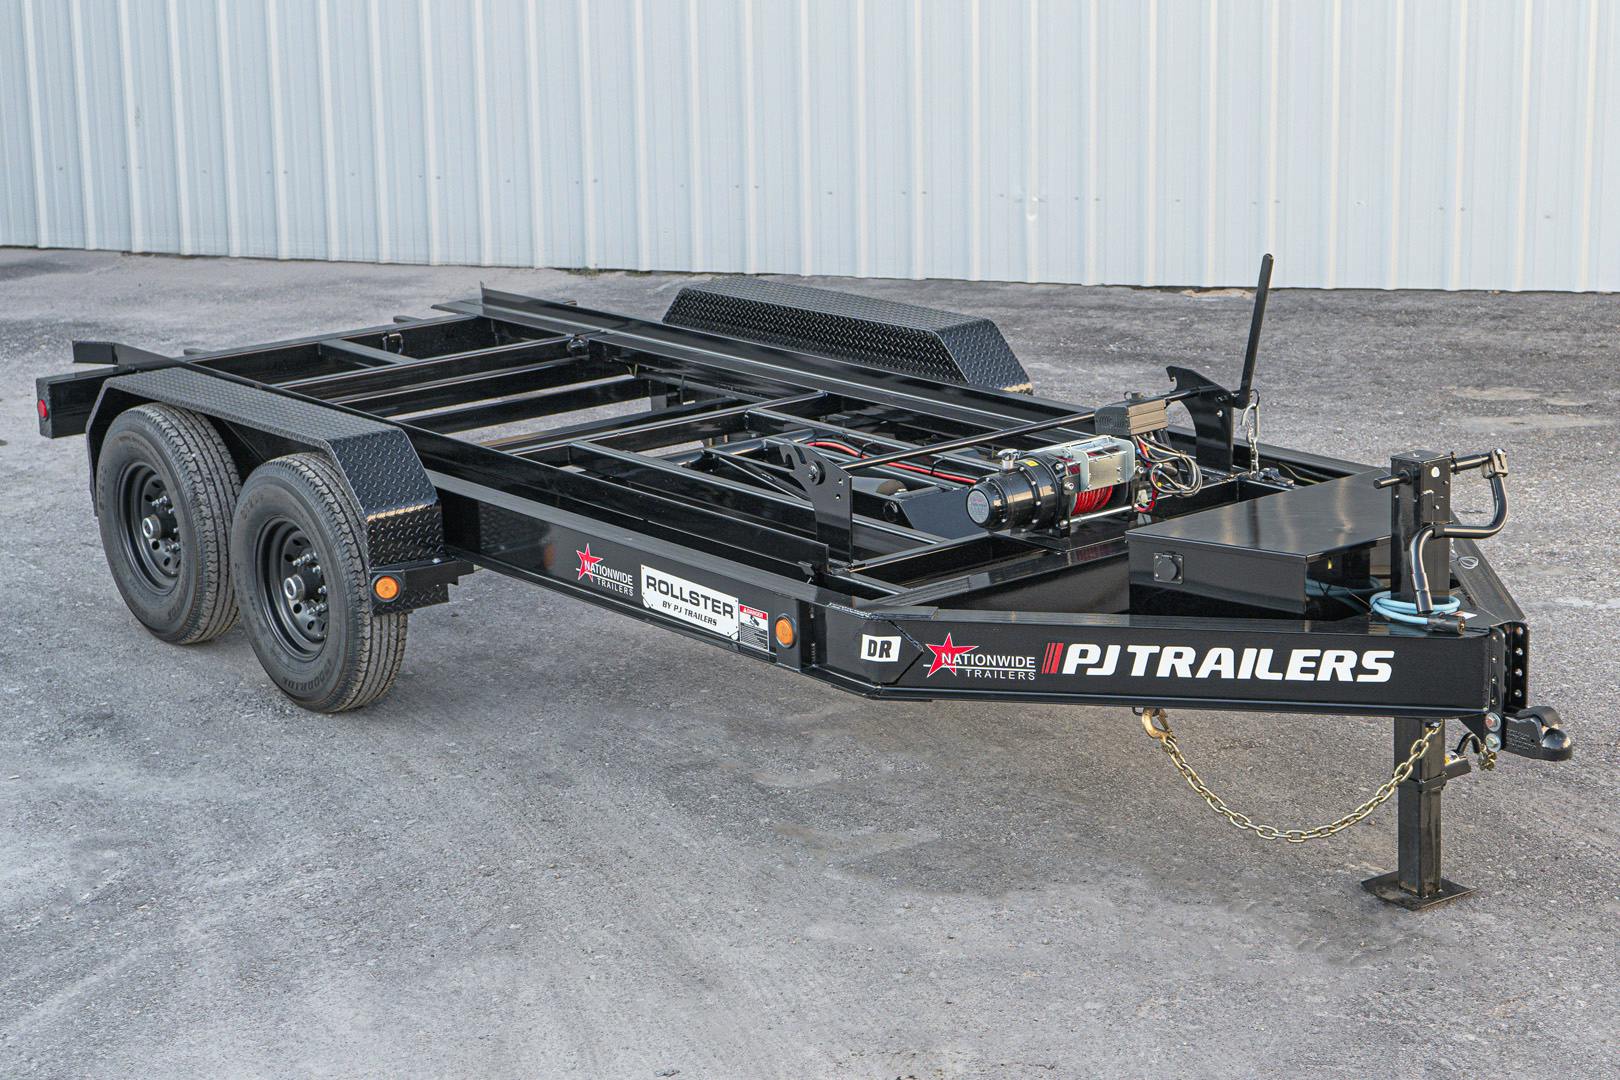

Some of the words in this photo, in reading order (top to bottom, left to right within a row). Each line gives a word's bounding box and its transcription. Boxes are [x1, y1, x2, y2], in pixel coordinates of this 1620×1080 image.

[584, 560, 633, 585] NATIONWIDE
[596, 577, 633, 597] TRAILERS
[646, 574, 734, 619] ROLLSTER
[662, 600, 671, 610] BY
[673, 604, 682, 613] PJ
[684, 608, 717, 626] TRAILERS
[867, 639, 893, 659] DR
[941, 652, 1036, 668] NATIONWIDE
[1062, 643, 1121, 676] PJ
[1127, 644, 1395, 683] TRAILERS
[966, 669, 1036, 681] TRAILERS
